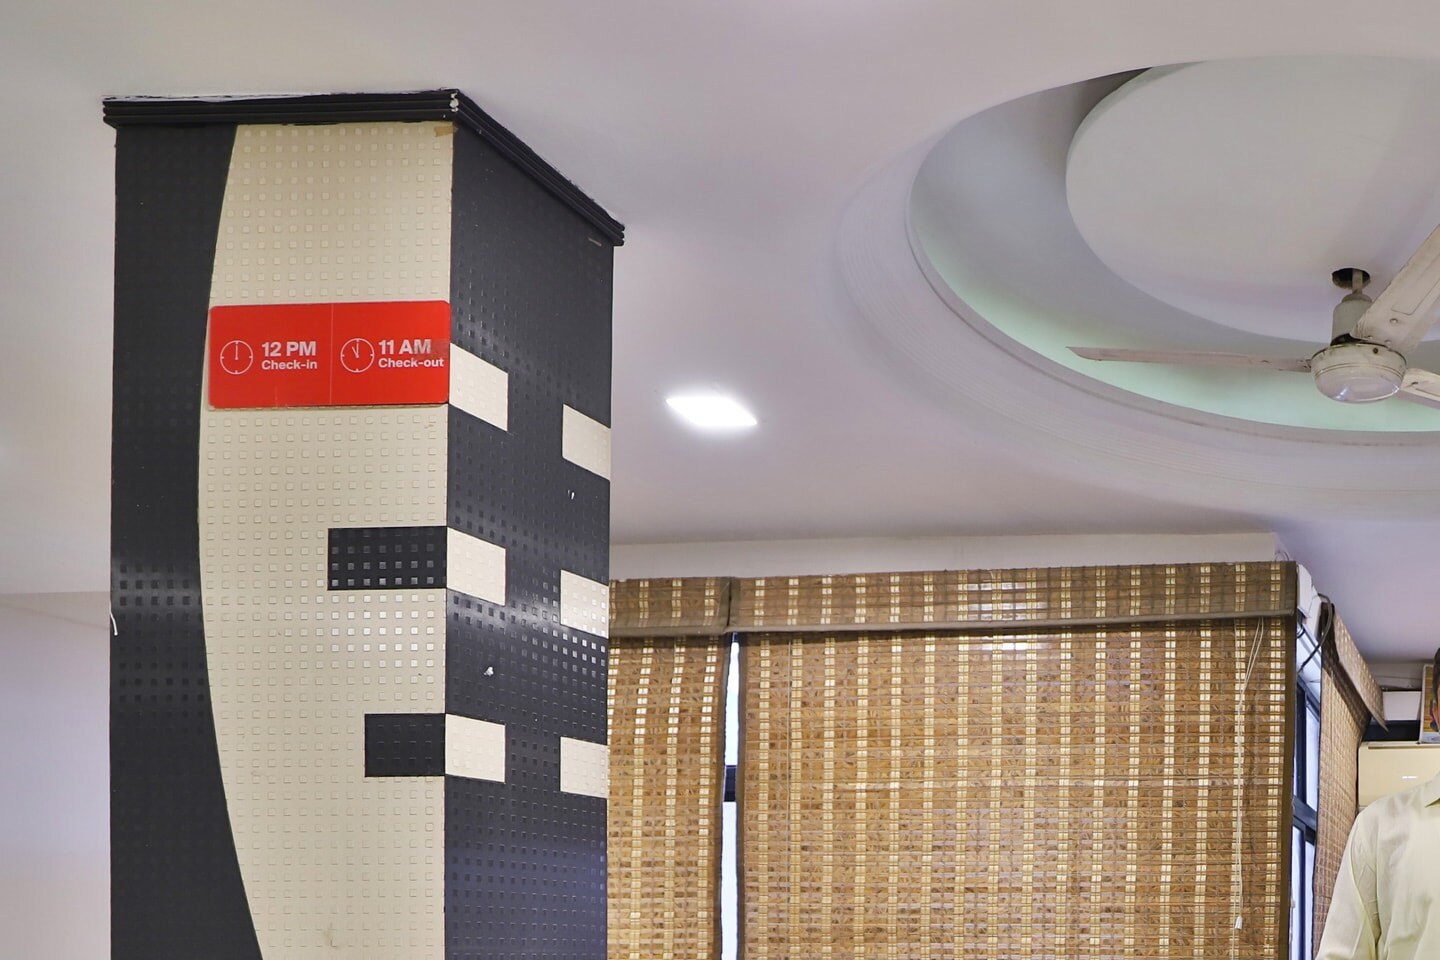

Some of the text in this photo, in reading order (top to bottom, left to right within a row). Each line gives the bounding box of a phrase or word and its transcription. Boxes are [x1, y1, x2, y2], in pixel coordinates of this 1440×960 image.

[262, 341, 317, 357] 12 PM
[378, 339, 432, 355] 11 AM
[261, 359, 318, 370] Check-in
[378, 357, 444, 369] Check-out
